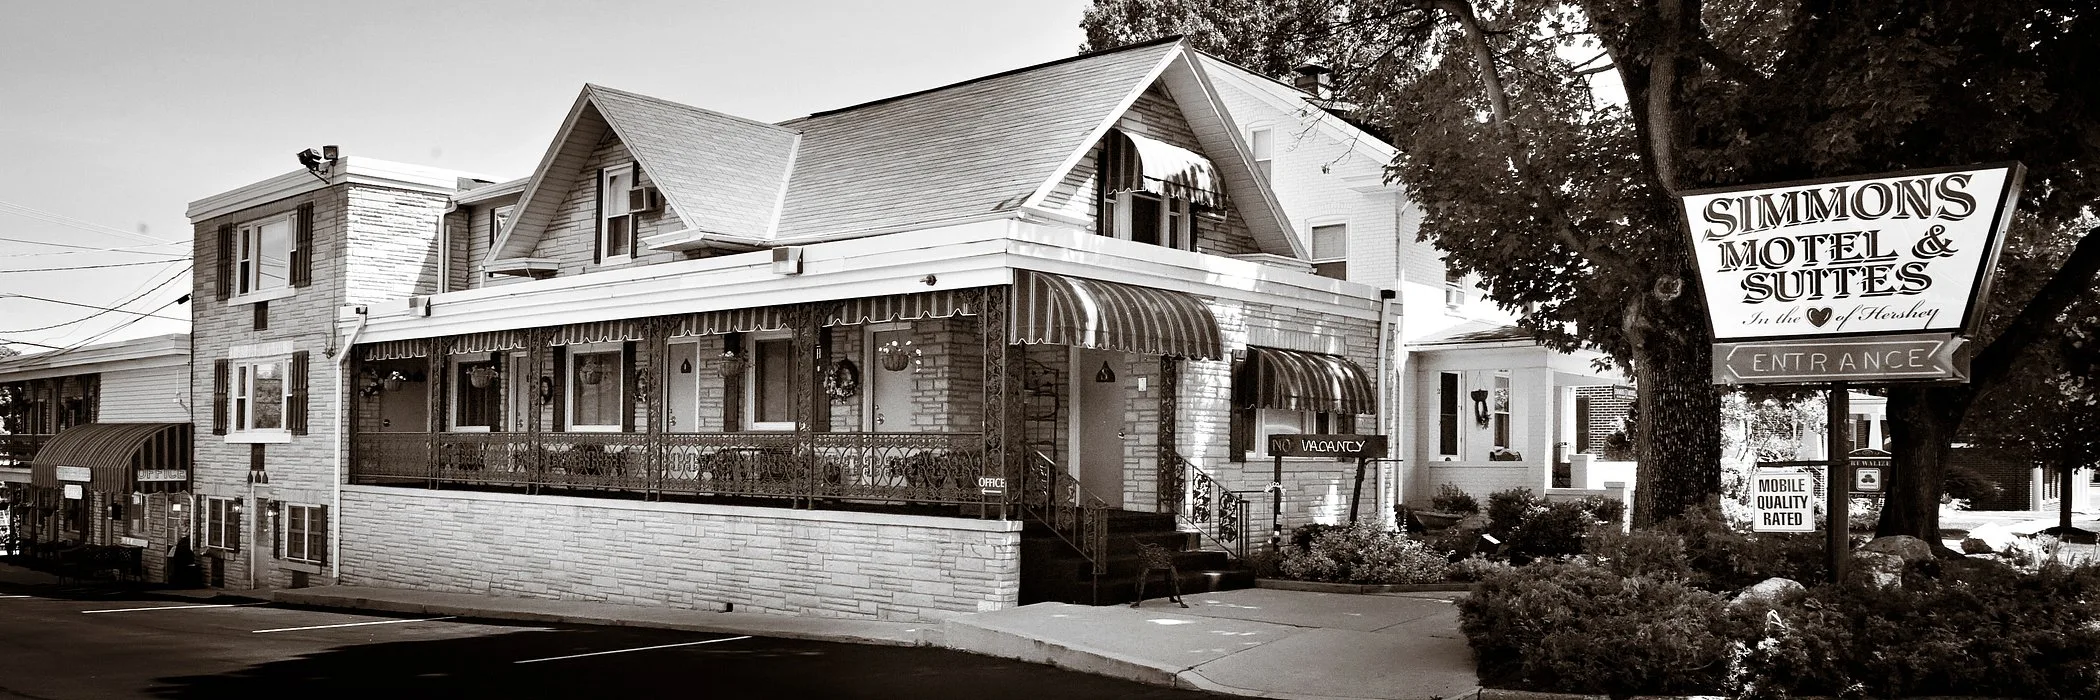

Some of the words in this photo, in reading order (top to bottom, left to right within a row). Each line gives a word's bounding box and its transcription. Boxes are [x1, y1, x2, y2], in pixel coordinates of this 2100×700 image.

[1702, 173, 1977, 242] SIMMONS
[1717, 230, 1898, 272] MOTEL
[1911, 224, 1960, 260] &
[1740, 261, 1932, 304] SUITES
[1741, 310, 1770, 326] In
[1775, 305, 1802, 325] the
[1835, 303, 1862, 332] of
[1857, 299, 1940, 331] Hershey
[1752, 348, 1926, 373] ENTRANCE
[1271, 438, 1291, 453] NO
[1301, 438, 1366, 453] VACANCY
[137, 469, 186, 480] OFFICE
[978, 476, 1005, 488] OFFICE
[1758, 478, 1806, 493] MOBILE
[1757, 495, 1809, 511] QUALITY
[1763, 512, 1803, 526] RATED
